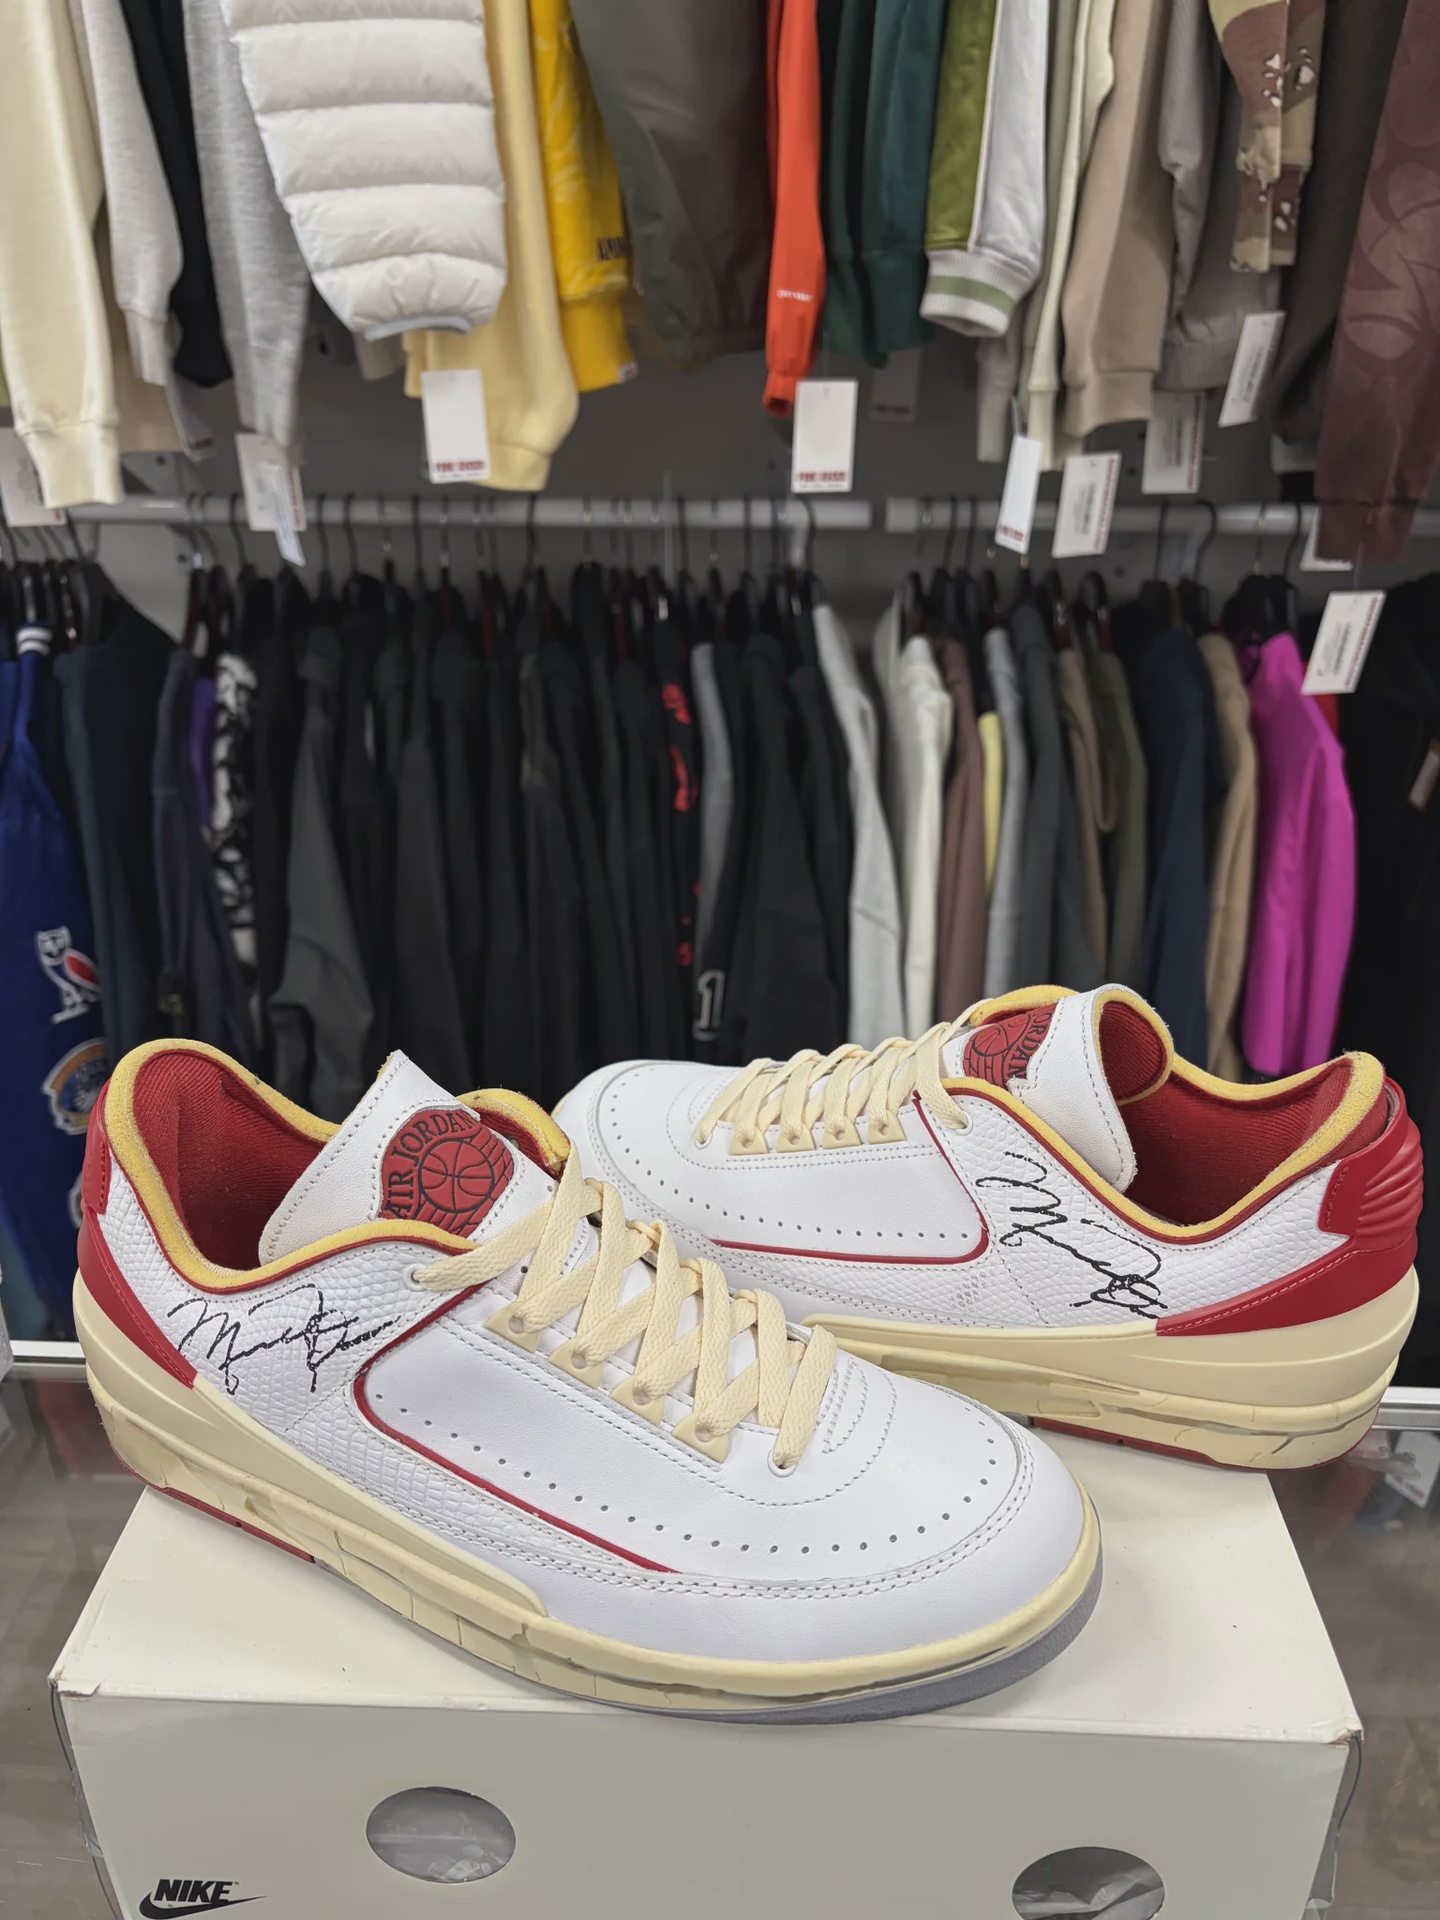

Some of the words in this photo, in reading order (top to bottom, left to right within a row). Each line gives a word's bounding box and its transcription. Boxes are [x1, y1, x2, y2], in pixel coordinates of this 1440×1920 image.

[1006, 1011, 1053, 1080] ORDAN
[390, 1110, 477, 1167] JORDAN
[384, 1169, 414, 1220] AIR
[153, 1878, 234, 1905] NIKE
